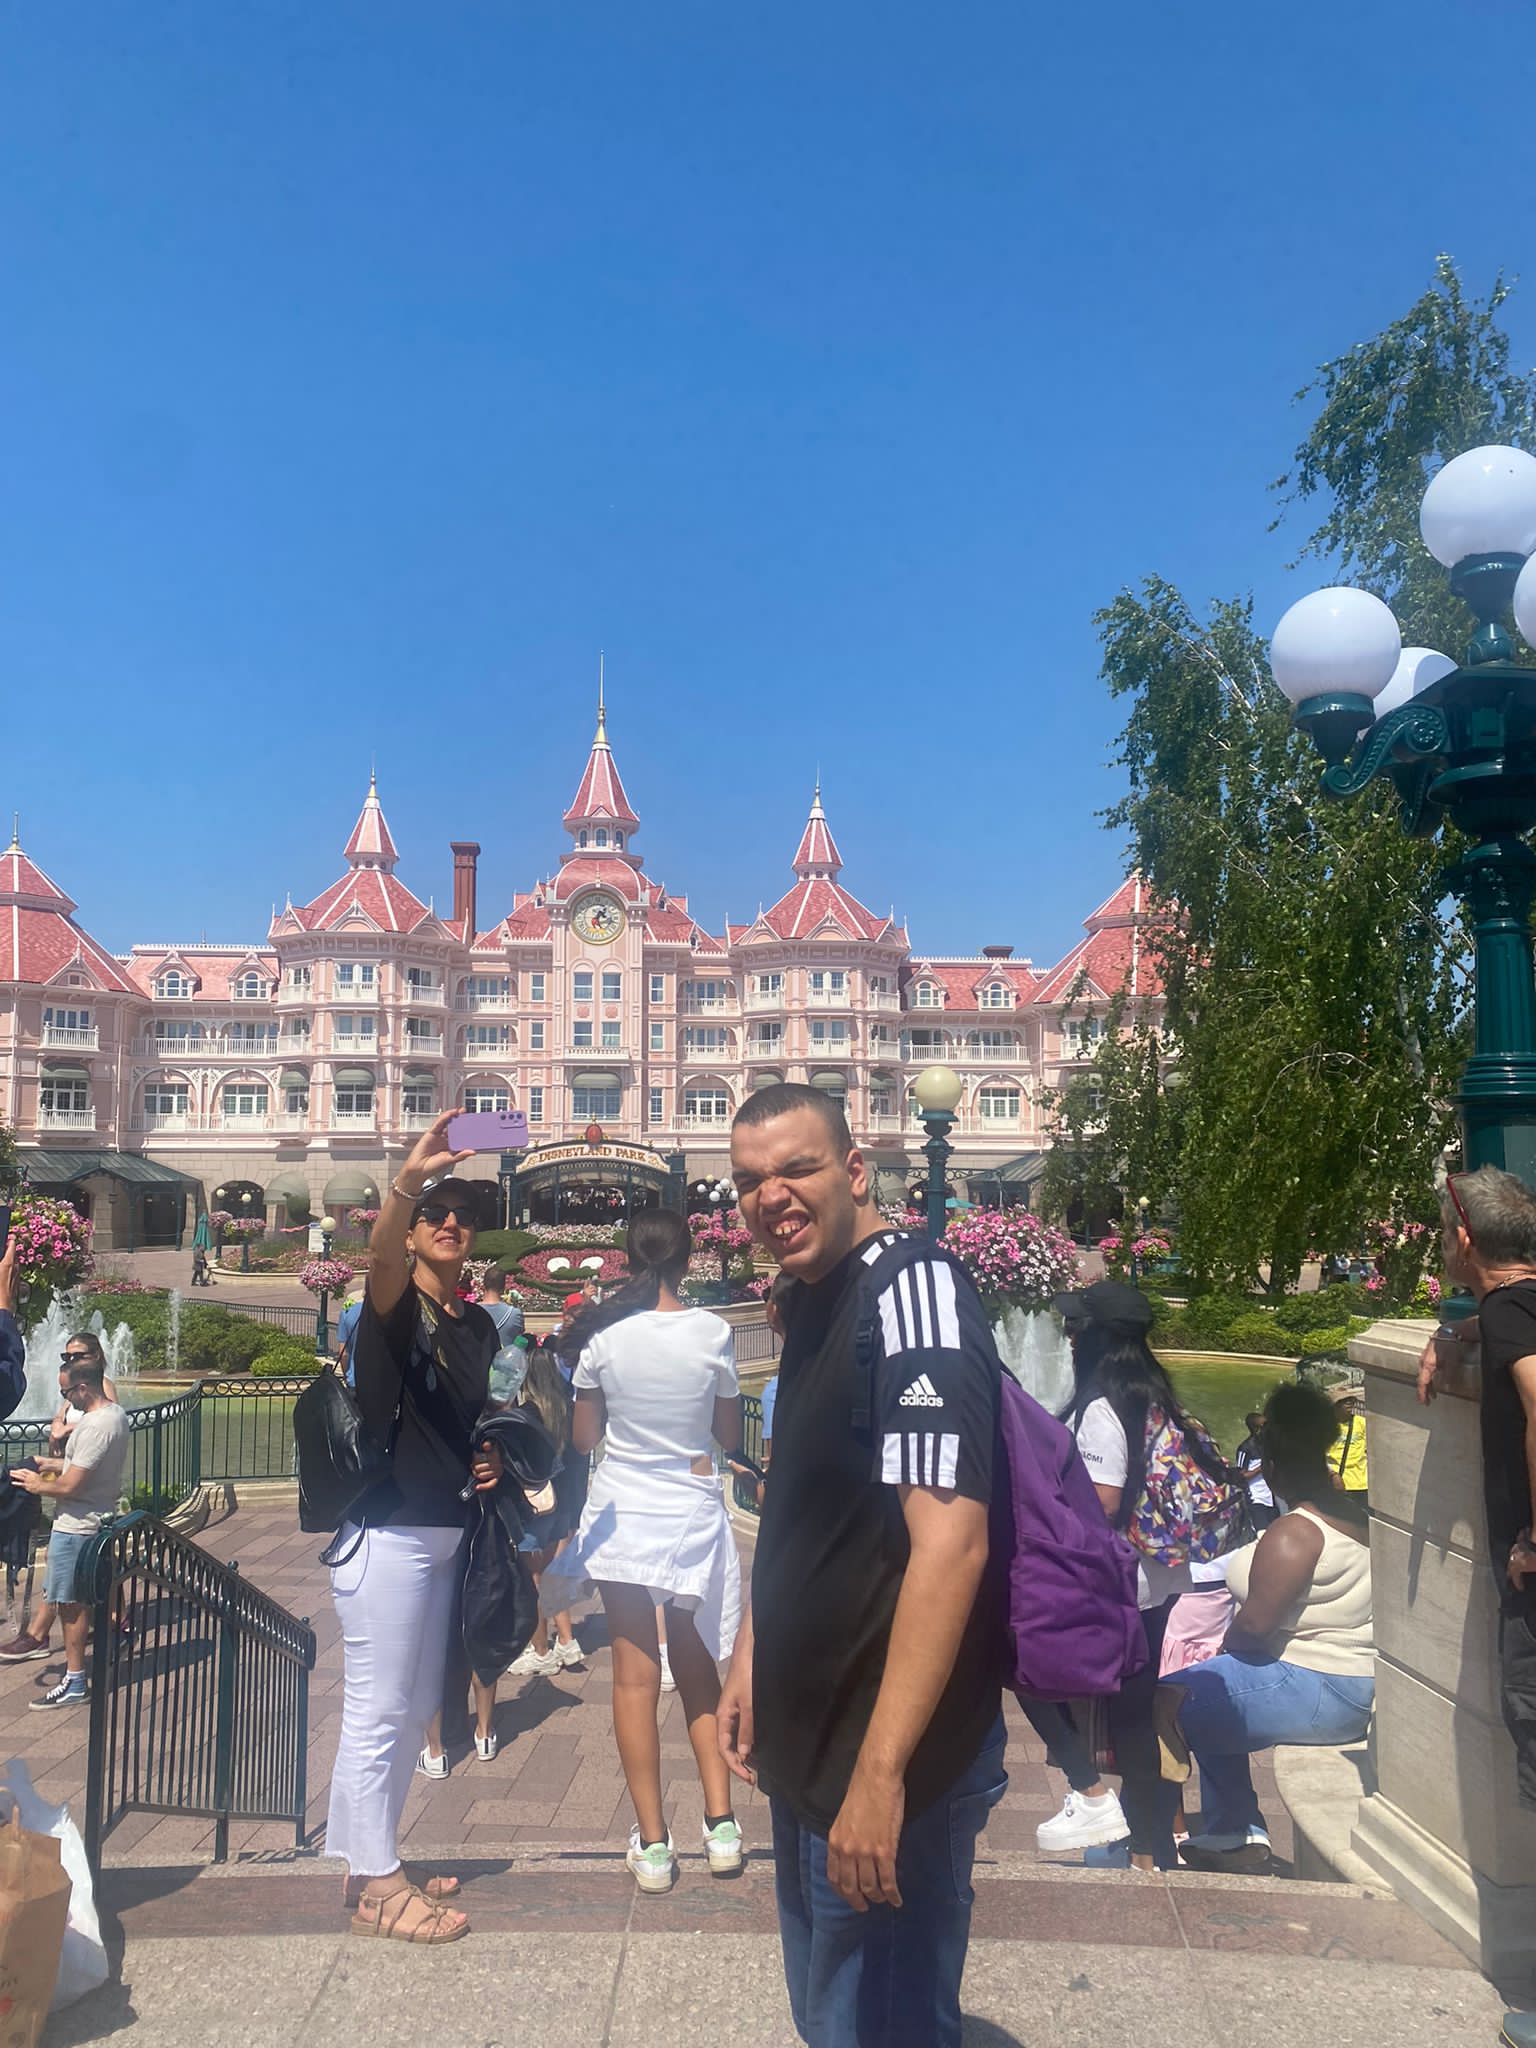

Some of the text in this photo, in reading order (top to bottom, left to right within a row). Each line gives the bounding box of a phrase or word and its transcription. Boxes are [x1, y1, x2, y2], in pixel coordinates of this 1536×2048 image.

[540, 1146, 646, 1161] DISNEYLAND PARK
[899, 1394, 944, 1408] adidas
